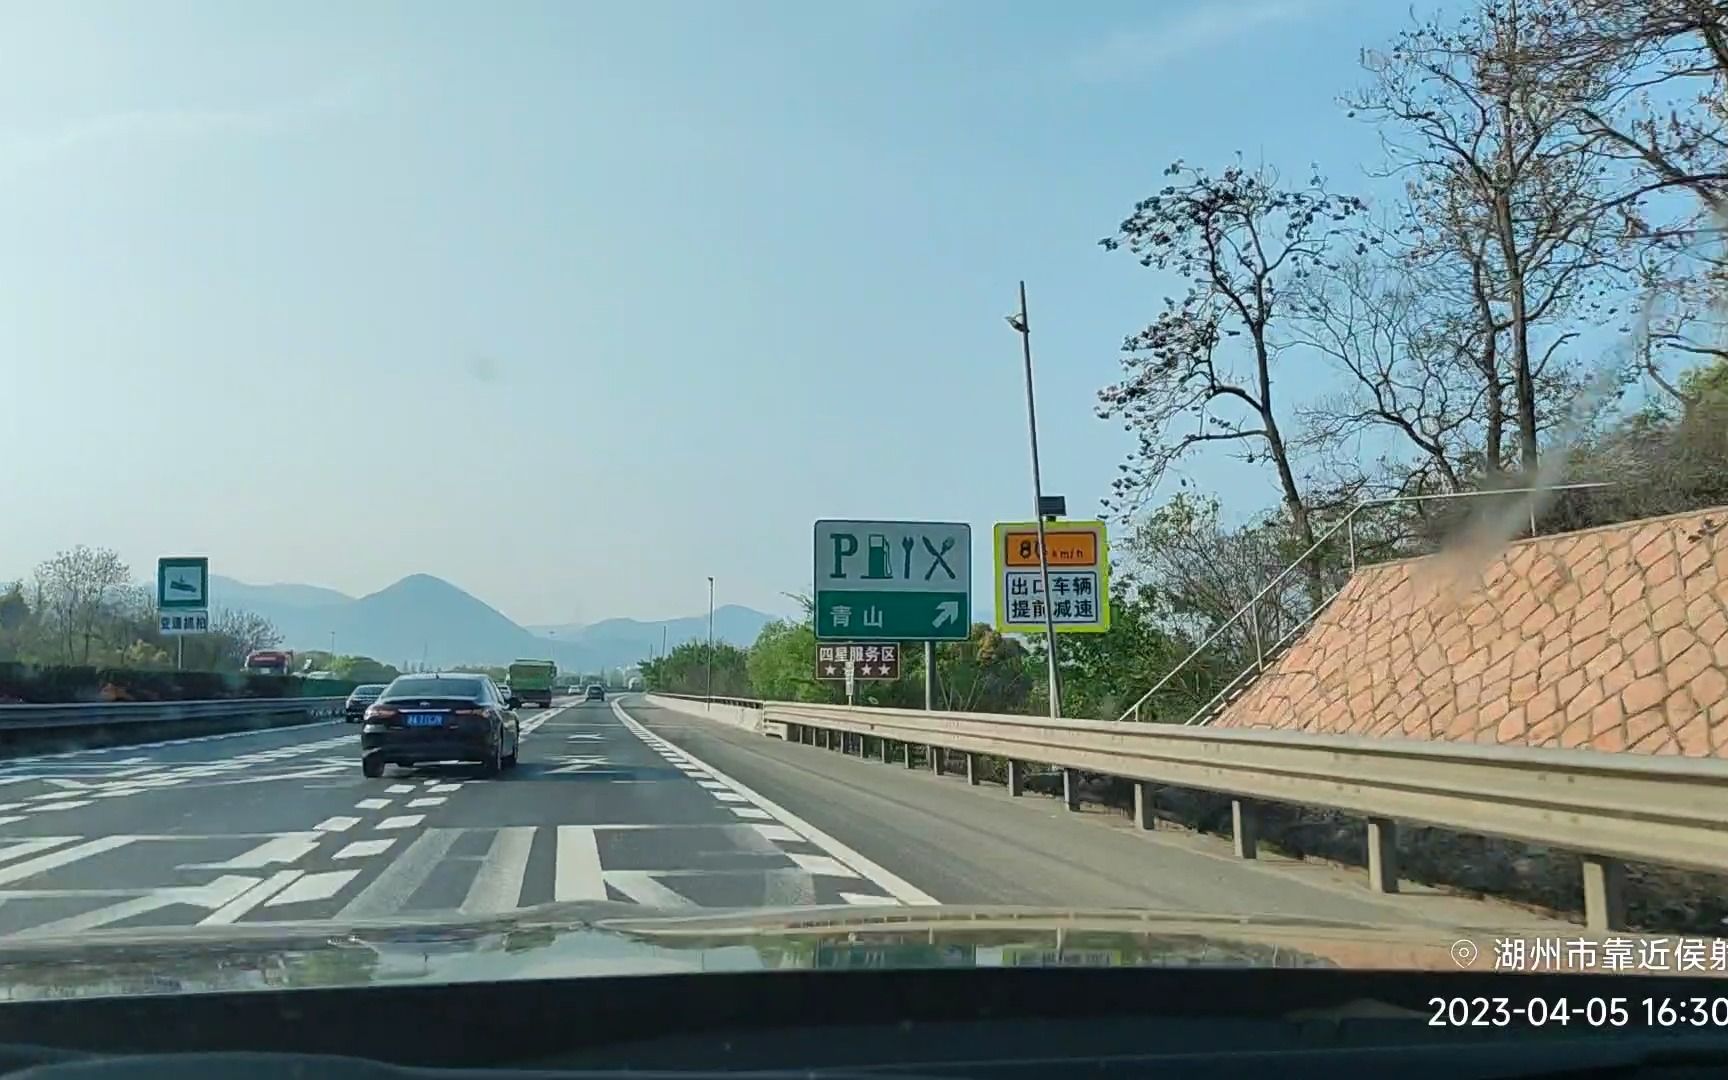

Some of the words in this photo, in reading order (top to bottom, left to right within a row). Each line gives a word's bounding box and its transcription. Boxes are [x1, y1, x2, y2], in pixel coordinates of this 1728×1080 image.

[1011, 577, 1092, 596] 出口车辆
[830, 605, 883, 628] 青山
[1011, 599, 1094, 618] 提前减速
[819, 646, 896, 662] 四星服务区
